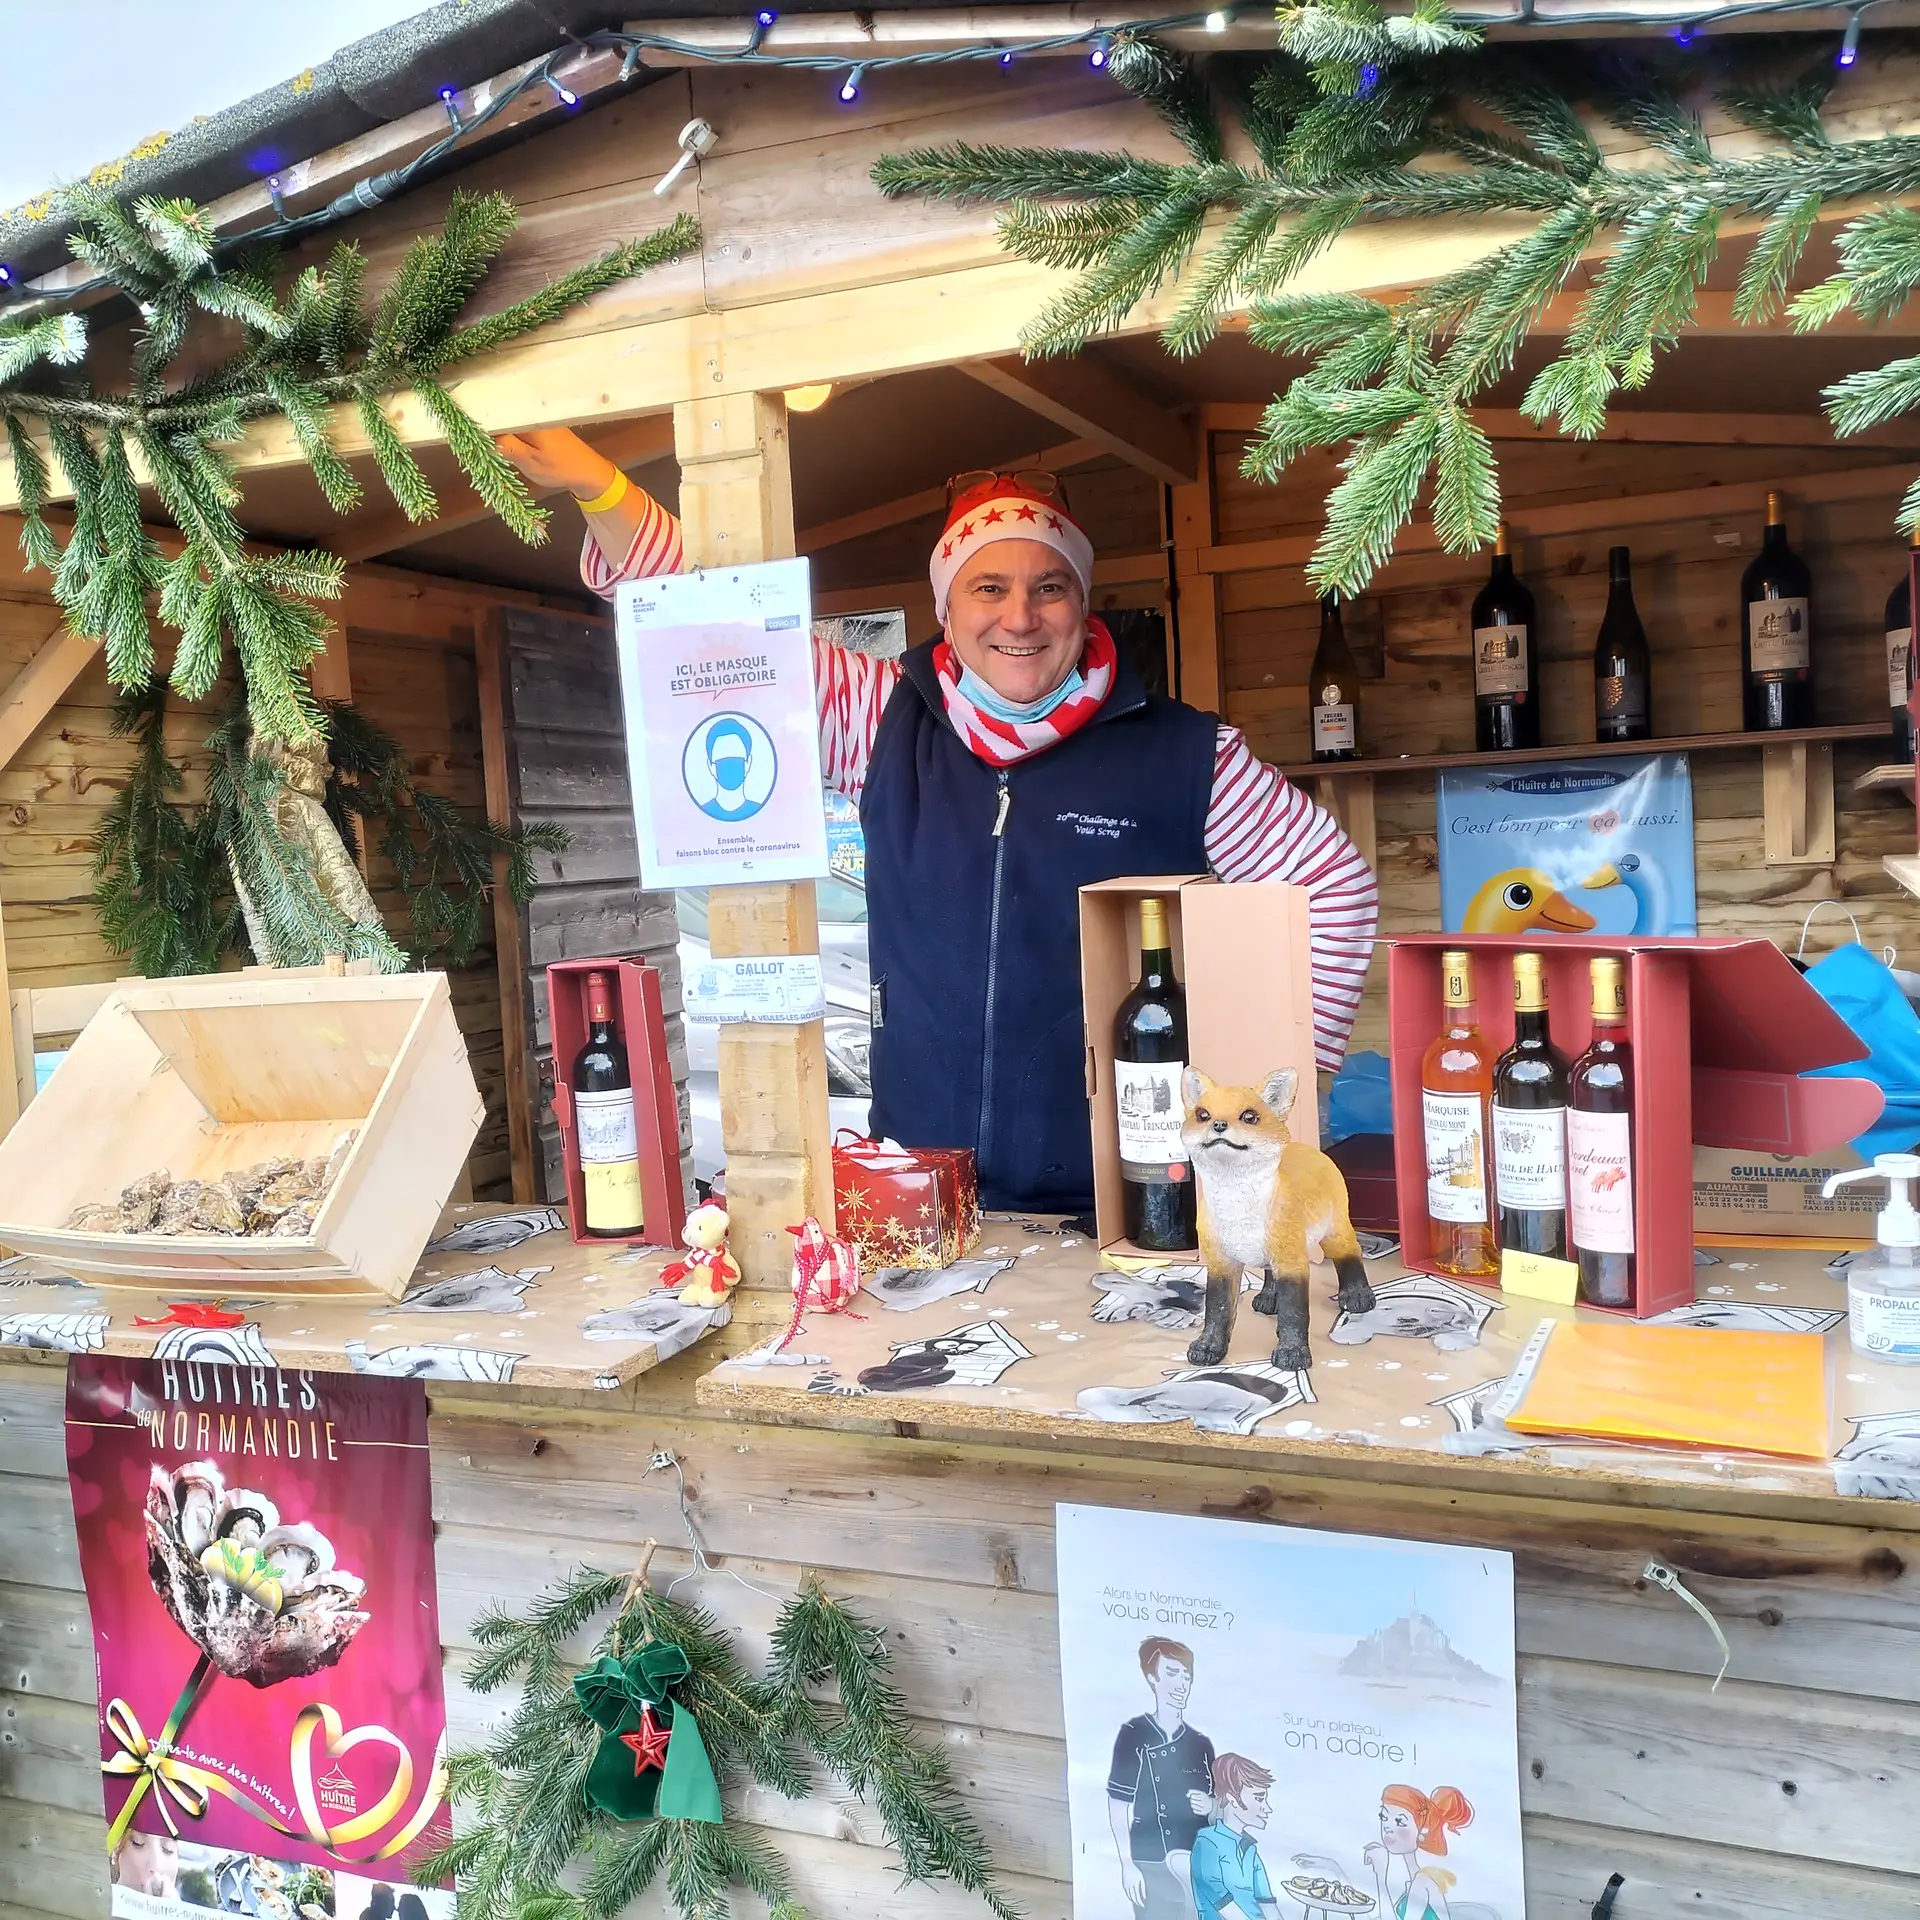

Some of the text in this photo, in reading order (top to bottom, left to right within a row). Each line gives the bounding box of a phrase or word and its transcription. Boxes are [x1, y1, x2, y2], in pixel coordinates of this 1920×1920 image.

[676, 655, 768, 677] ICI, LE MASQUE
[671, 669, 777, 691] EST OBLIGATOIRE
[1510, 774, 1616, 791] l'Huître de Normandie
[1079, 815, 1118, 827] Challenge
[1119, 818, 1129, 827] de
[1498, 814, 1532, 833] bon
[1593, 817, 1616, 834] ça
[717, 835, 756, 844] Ensemble,
[676, 841, 801, 858] faisons bloc contre le coronavirus
[735, 962, 785, 976] GALLOT
[1425, 1100, 1470, 1116] MARQUISE
[1141, 1117, 1181, 1131] TRINCAUD
[1448, 1120, 1467, 1129] MONT
[1519, 1165, 1534, 1174] DE
[1706, 1183, 1751, 1191] AUMALE
[1836, 1186, 1851, 1194] EU
[137, 1408, 338, 1461] de NORMANDIE
[1103, 1586, 1132, 1600] Alors
[1135, 1589, 1147, 1602] la
[1103, 1602, 1235, 1631] vous aimez ?
[1283, 1711, 1304, 1726] Sur
[1307, 1718, 1325, 1729] un
[1285, 1730, 1318, 1750] on
[1326, 1734, 1404, 1763] adore
[147, 1738, 297, 1821] Dites-le avec des huîtres !
[320, 1789, 357, 1807] HUÎTRE
[328, 1803, 357, 1814] NORMANDIE
